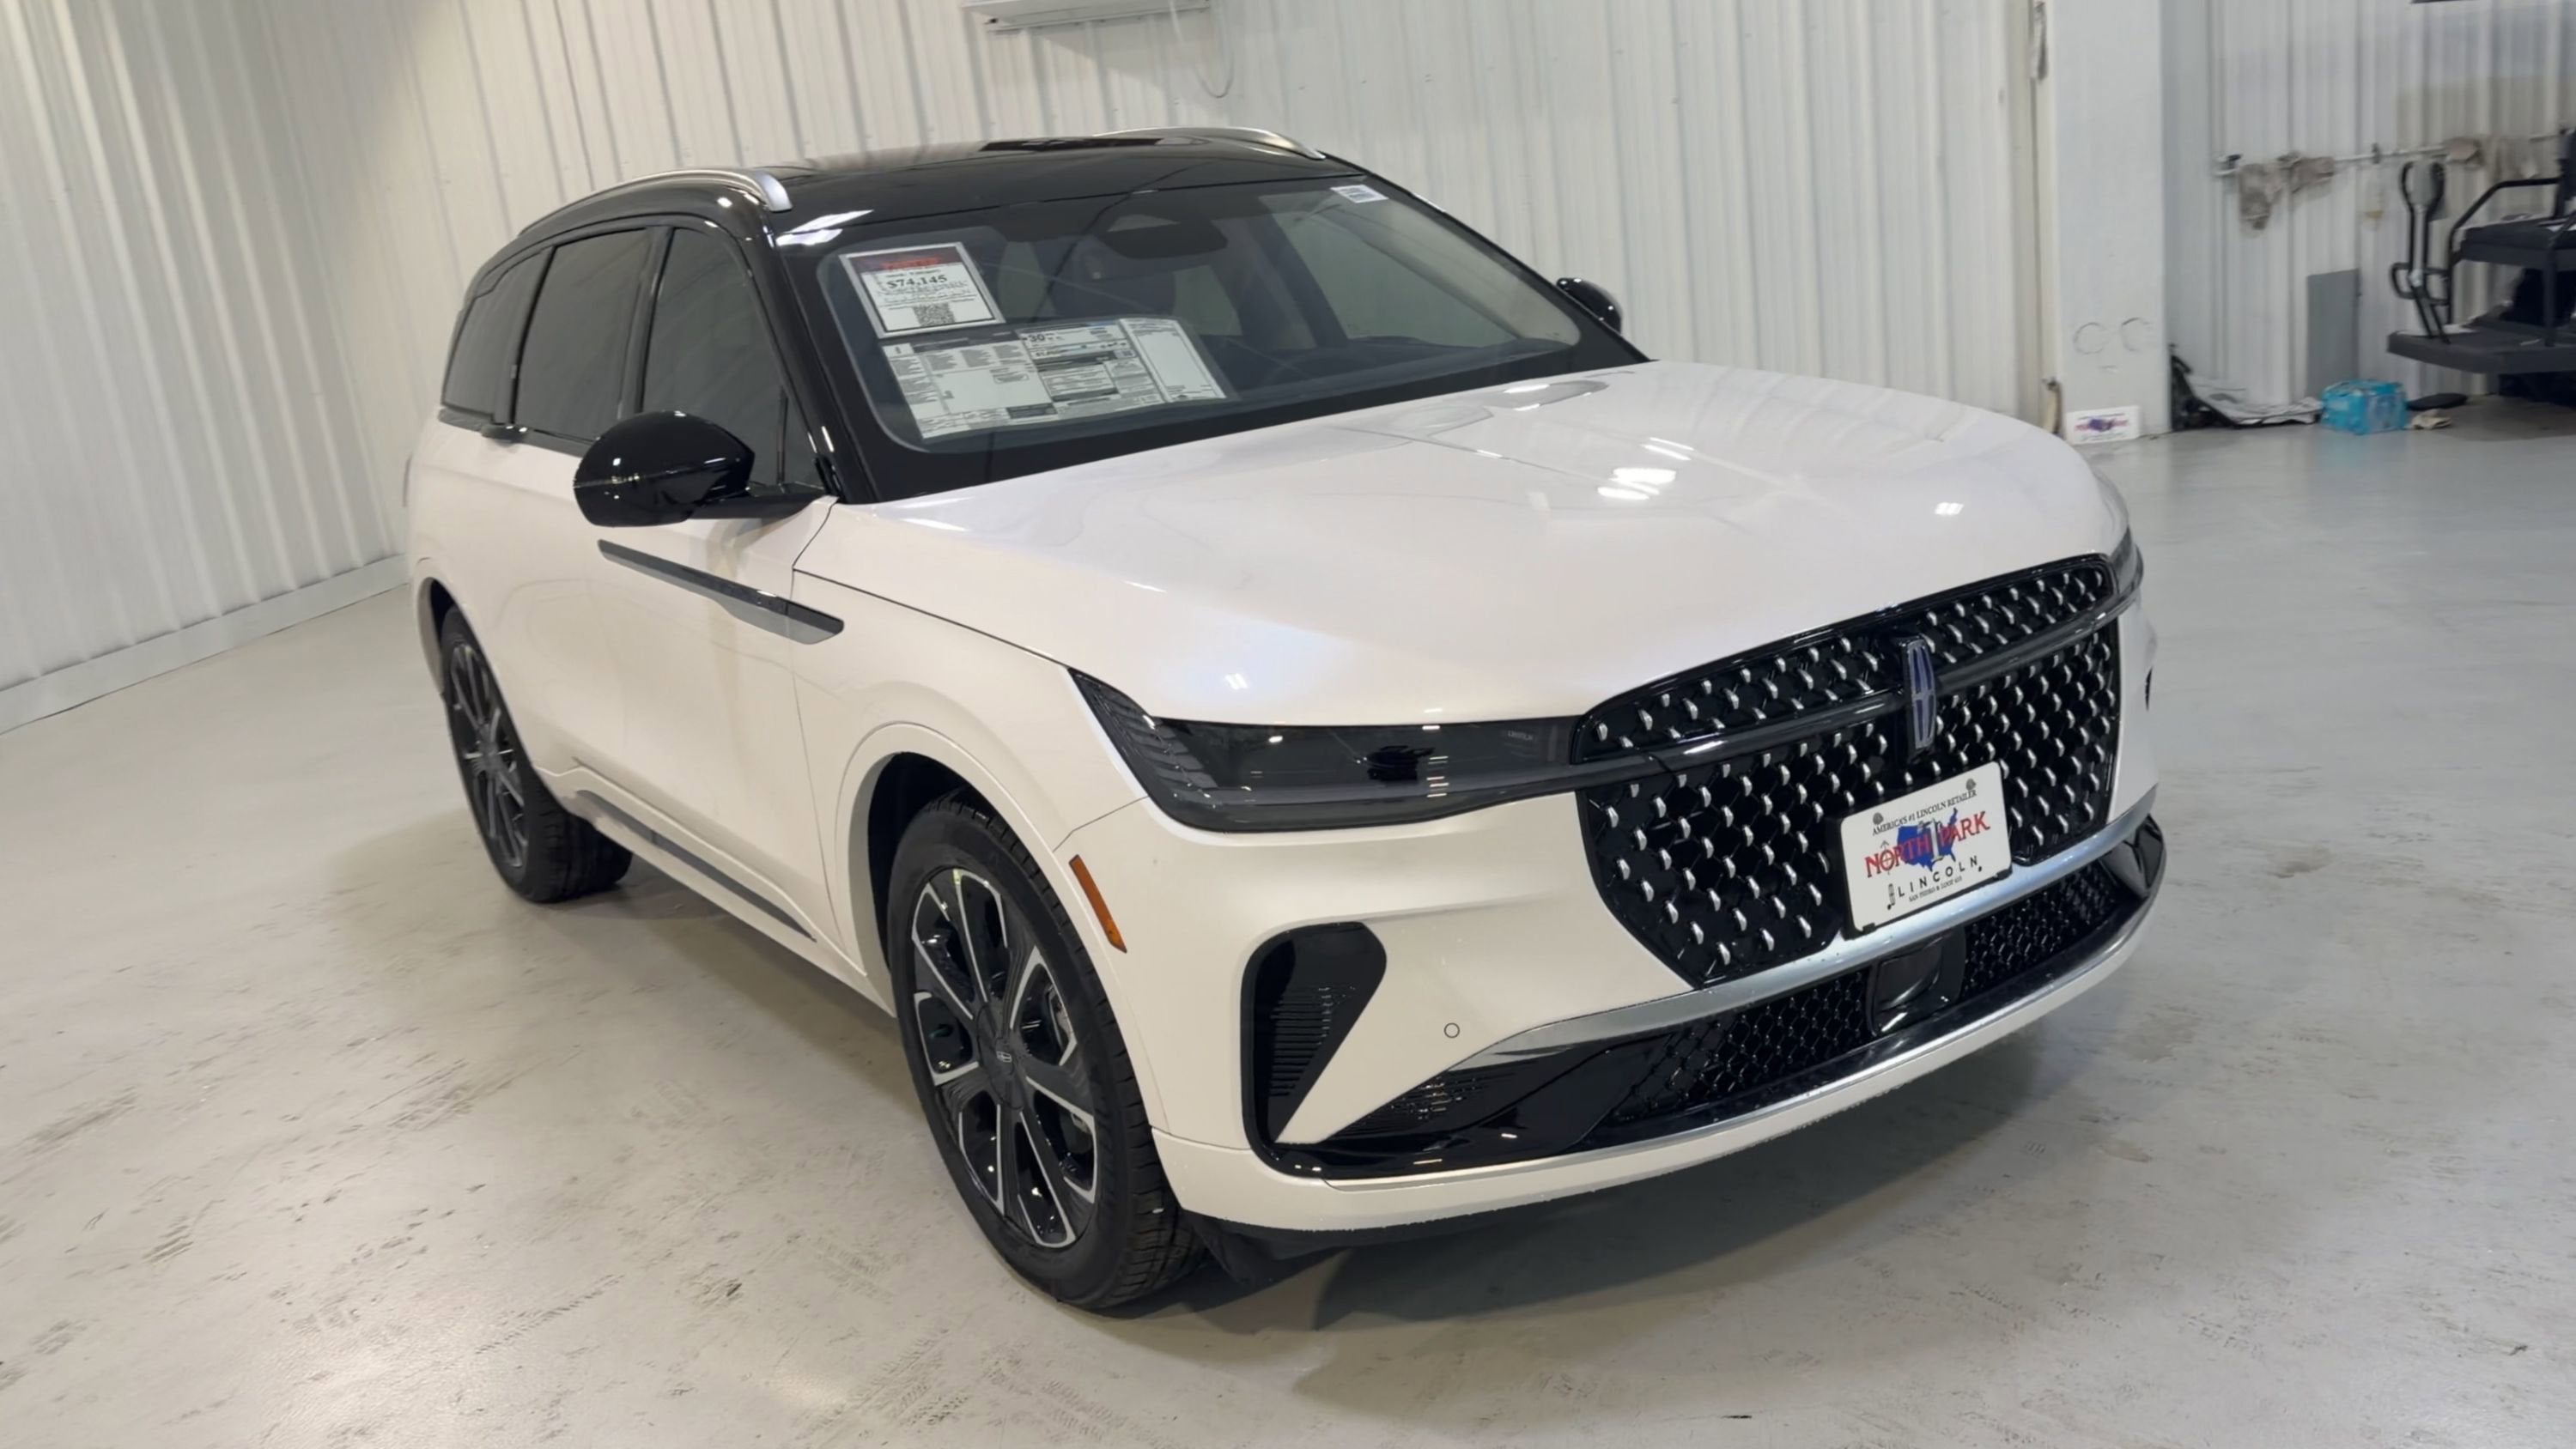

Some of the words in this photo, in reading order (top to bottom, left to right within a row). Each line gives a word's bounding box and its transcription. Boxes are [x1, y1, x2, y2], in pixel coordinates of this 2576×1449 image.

[1872, 815, 1907, 836] AMERICA'S
[1908, 811, 1916, 822] #1
[1916, 801, 1947, 819] LINCOLN
[1947, 790, 1978, 808] RETAILER
[1864, 833, 1933, 878] NORTH
[1937, 810, 1991, 846] PARK
[1898, 855, 1978, 898] LINCOLN
